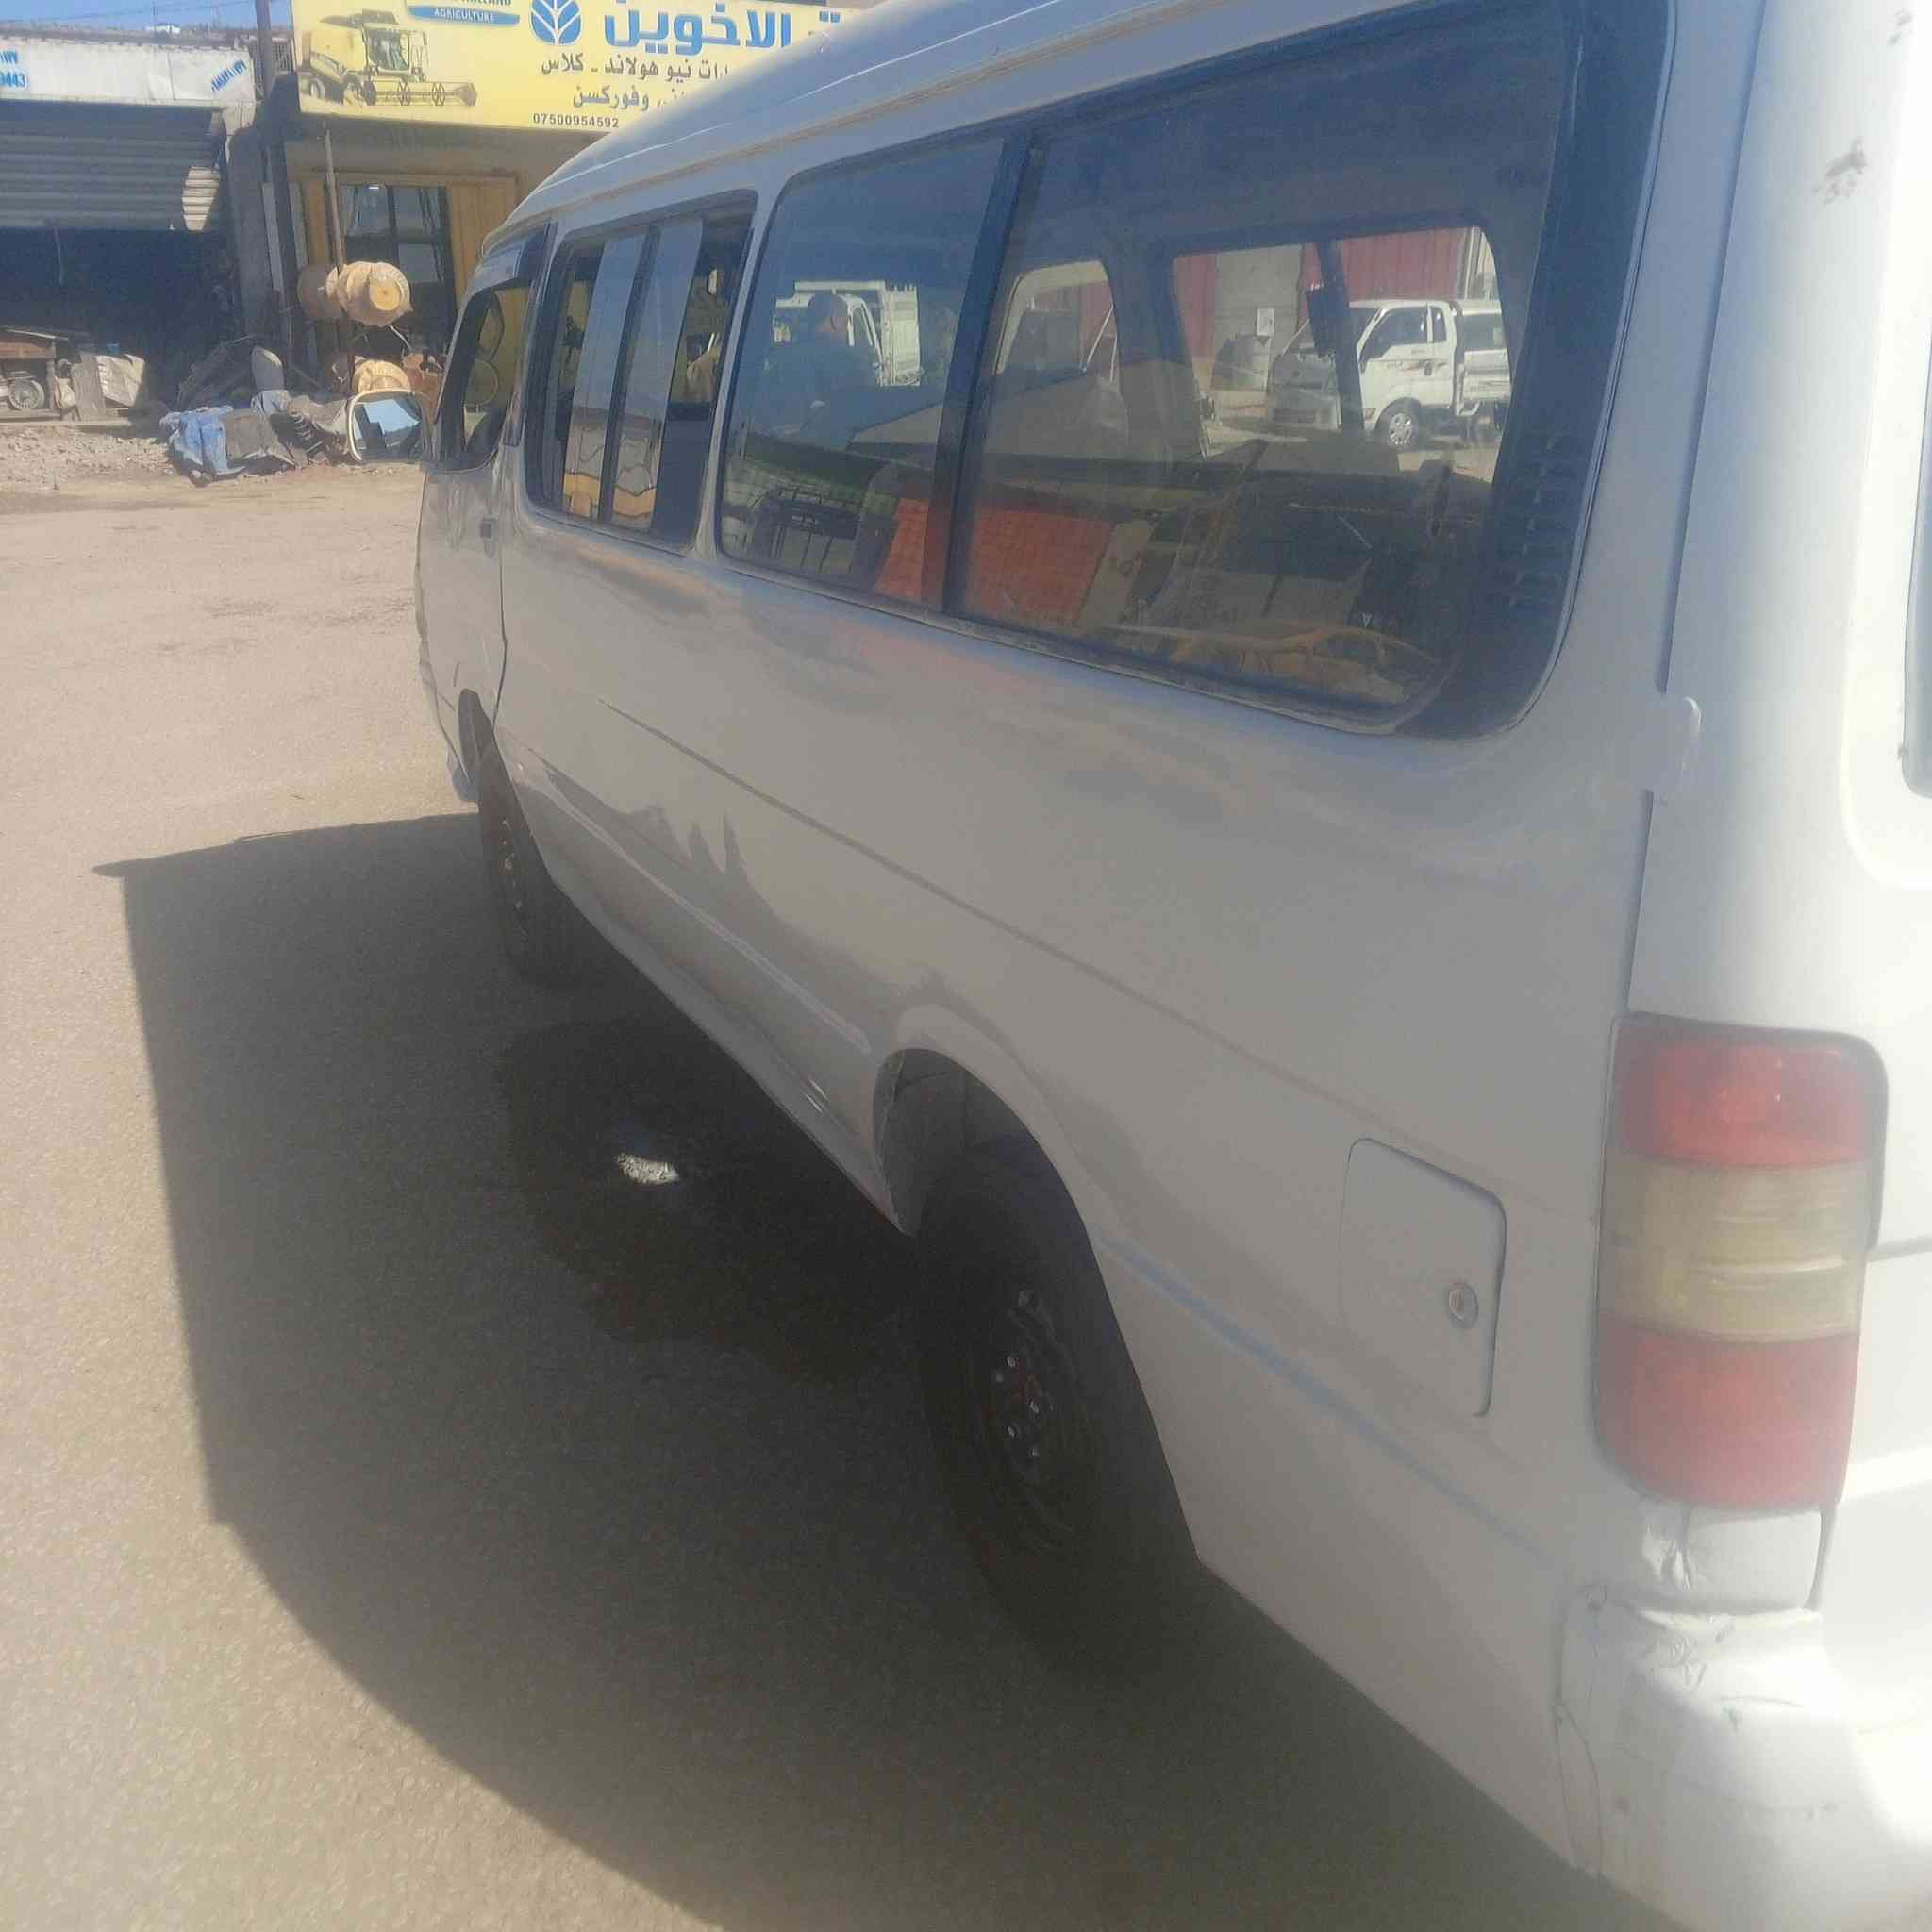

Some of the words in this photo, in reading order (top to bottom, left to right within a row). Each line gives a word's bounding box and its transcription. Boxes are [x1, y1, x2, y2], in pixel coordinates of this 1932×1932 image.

[433, 8, 494, 22] AGRICULTURE
[604, 0, 792, 56] الاخوين
[541, 52, 583, 75] كلاس
[605, 54, 658, 80] هولاند
[666, 58, 691, 83] نيو
[533, 112, 619, 128] 07500954592
